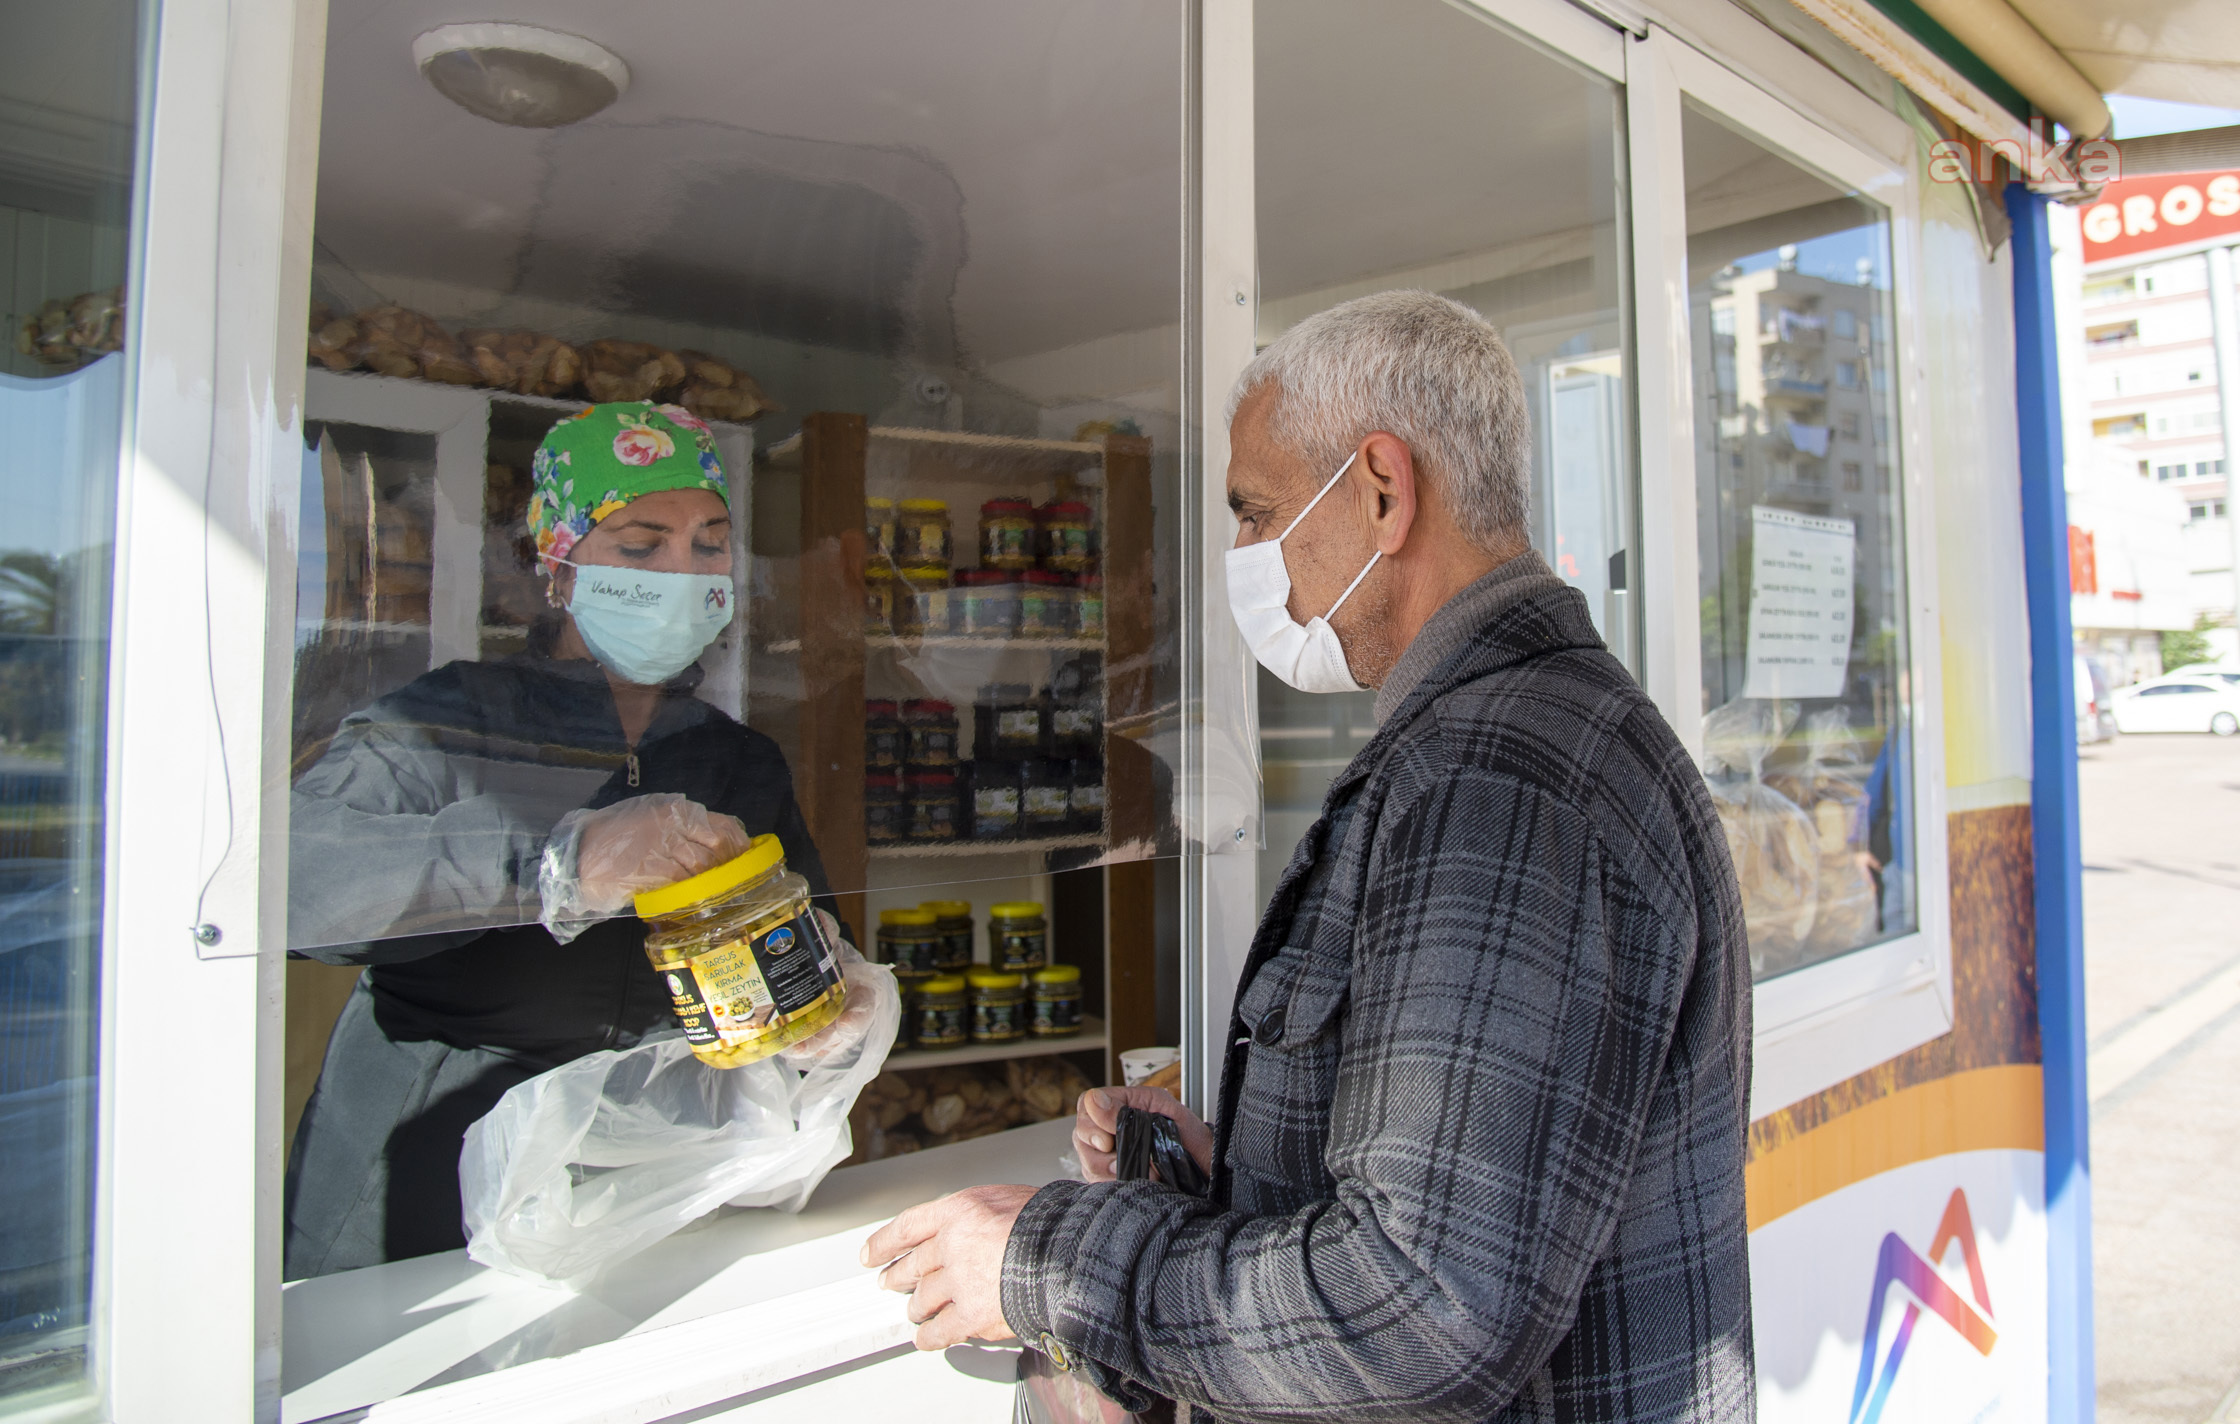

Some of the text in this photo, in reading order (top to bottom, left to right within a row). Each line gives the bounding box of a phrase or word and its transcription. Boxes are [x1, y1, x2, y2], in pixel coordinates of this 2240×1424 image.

[2083, 175, 2240, 243] GROS
[591, 580, 627, 598] Vahap
[704, 950, 737, 969] TARSUS
[703, 959, 746, 981] SARIULAK
[714, 973, 743, 990] KIRMA
[730, 976, 761, 997] ZEYTİN
